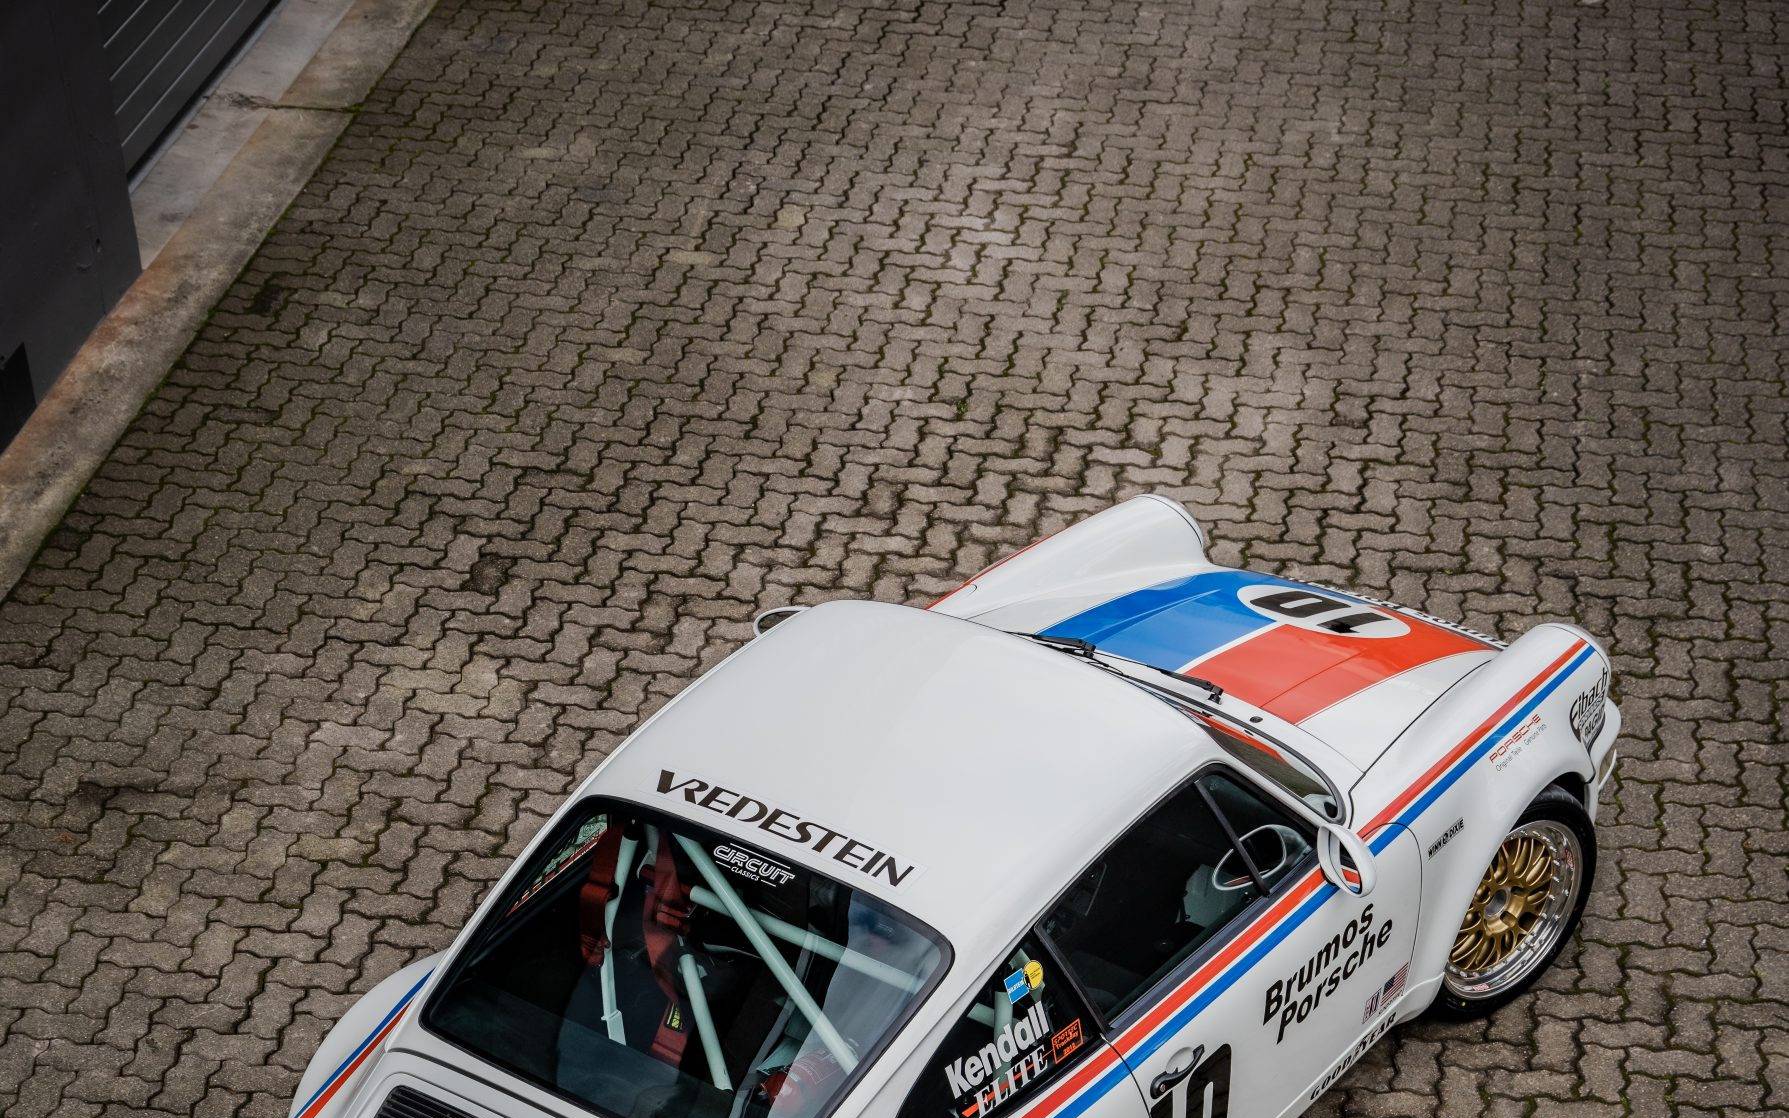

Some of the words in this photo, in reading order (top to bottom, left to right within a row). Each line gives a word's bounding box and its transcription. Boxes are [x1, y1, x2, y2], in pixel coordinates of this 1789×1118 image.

[1489, 713, 1541, 763] PORSCHE
[656, 769, 914, 888] VREDESTEIN
[713, 845, 795, 885] CIRCUIT
[1449, 818, 1464, 838] DIXIE
[731, 866, 760, 881] CLASSICS
[1262, 903, 1373, 1026] Brumos
[1276, 919, 1393, 1045] Porsche
[945, 1001, 1050, 1099] Kendall
